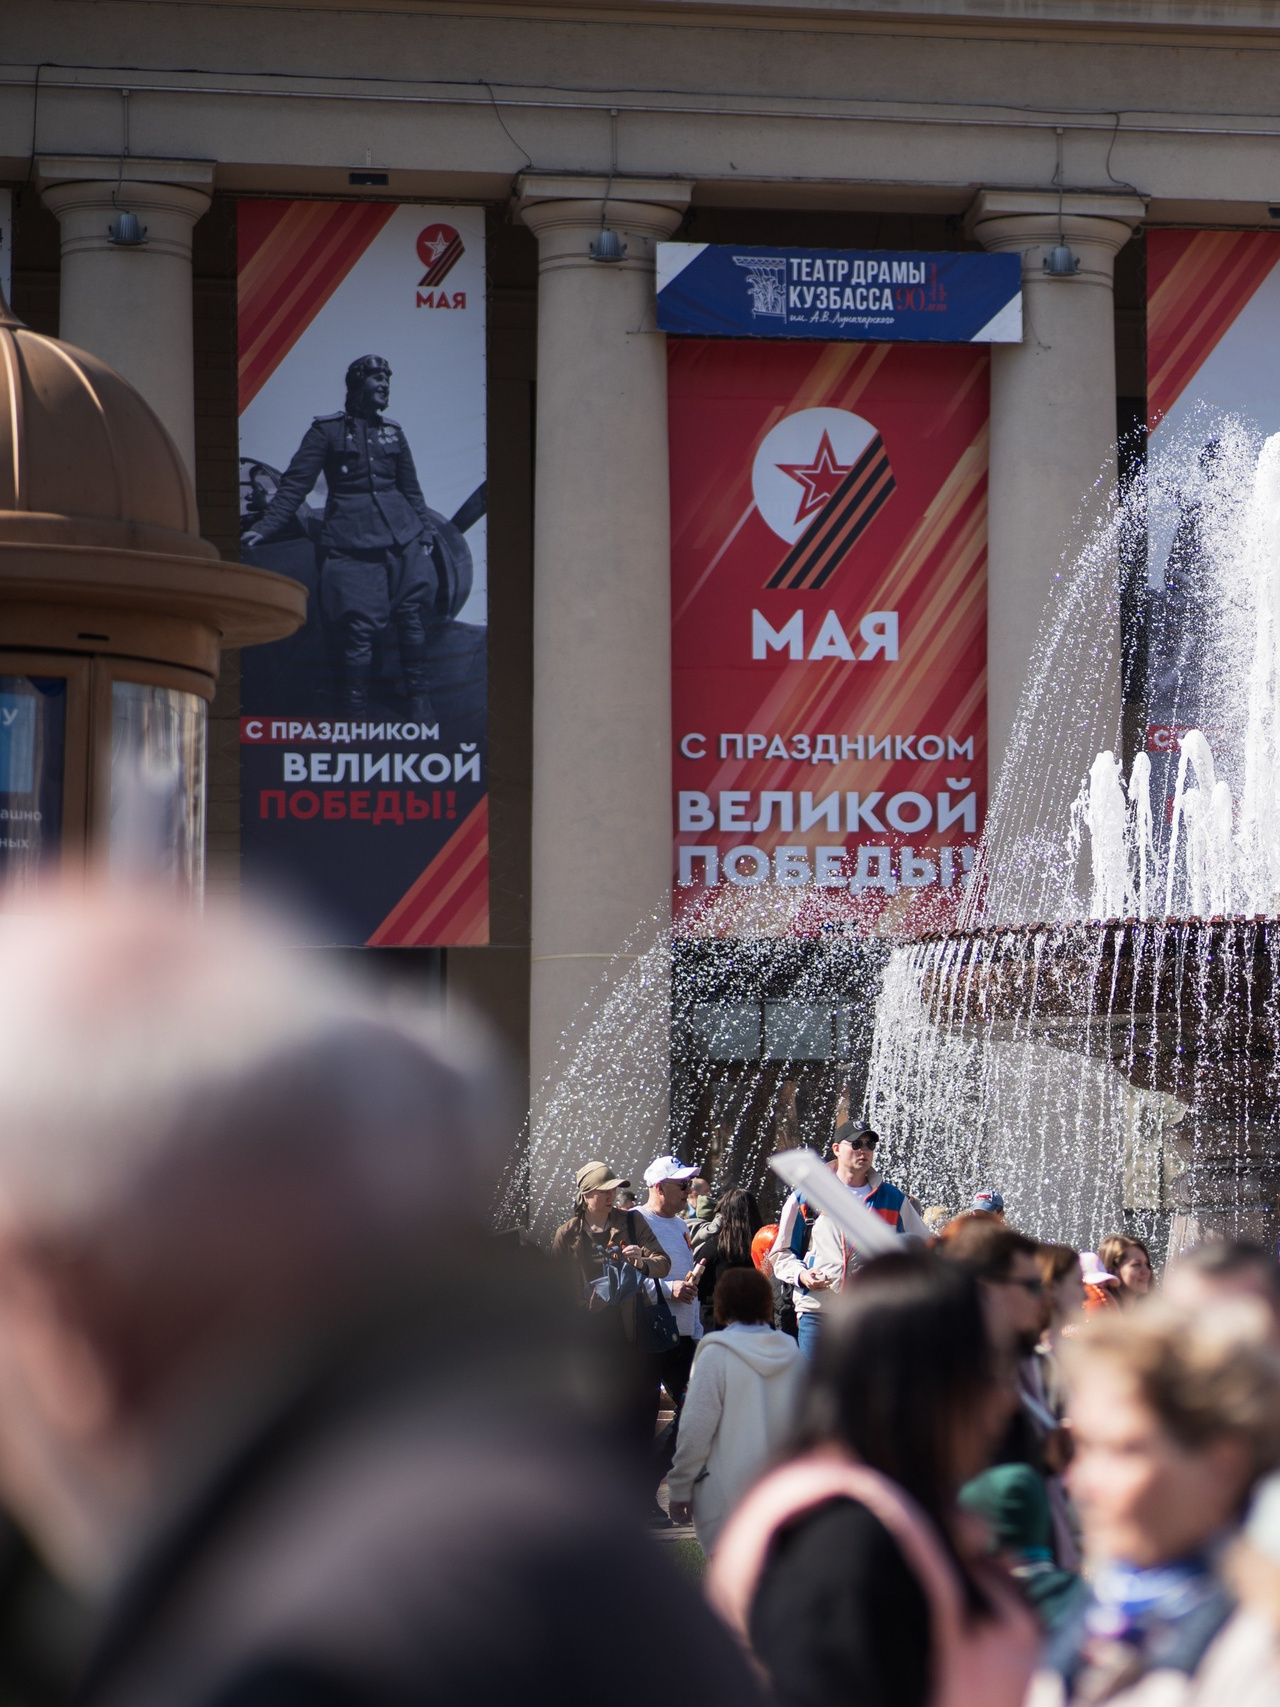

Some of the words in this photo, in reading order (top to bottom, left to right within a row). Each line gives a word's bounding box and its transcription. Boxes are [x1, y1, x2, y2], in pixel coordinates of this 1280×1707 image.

[790, 258, 848, 282] ТЕАТР
[851, 260, 926, 285] ДРАМЫ
[416, 291, 466, 309] МАЯ
[789, 286, 894, 311] КУЗБАССА
[895, 286, 926, 311] 90
[790, 314, 808, 322] им.
[752, 608, 899, 661] МАЯ
[246, 721, 263, 739] С
[271, 721, 440, 743] ПРАЗДНИКОМ
[283, 743, 481, 783] ВЕЛИКОЙ
[680, 733, 707, 759] С
[720, 733, 974, 765] ПРАЗДНИКОМ
[259, 790, 457, 825] ПОБЕДЫ!
[678, 778, 977, 833] ВЕЛИКОЙ
[678, 845, 976, 896] ПОБЕДЫ!
